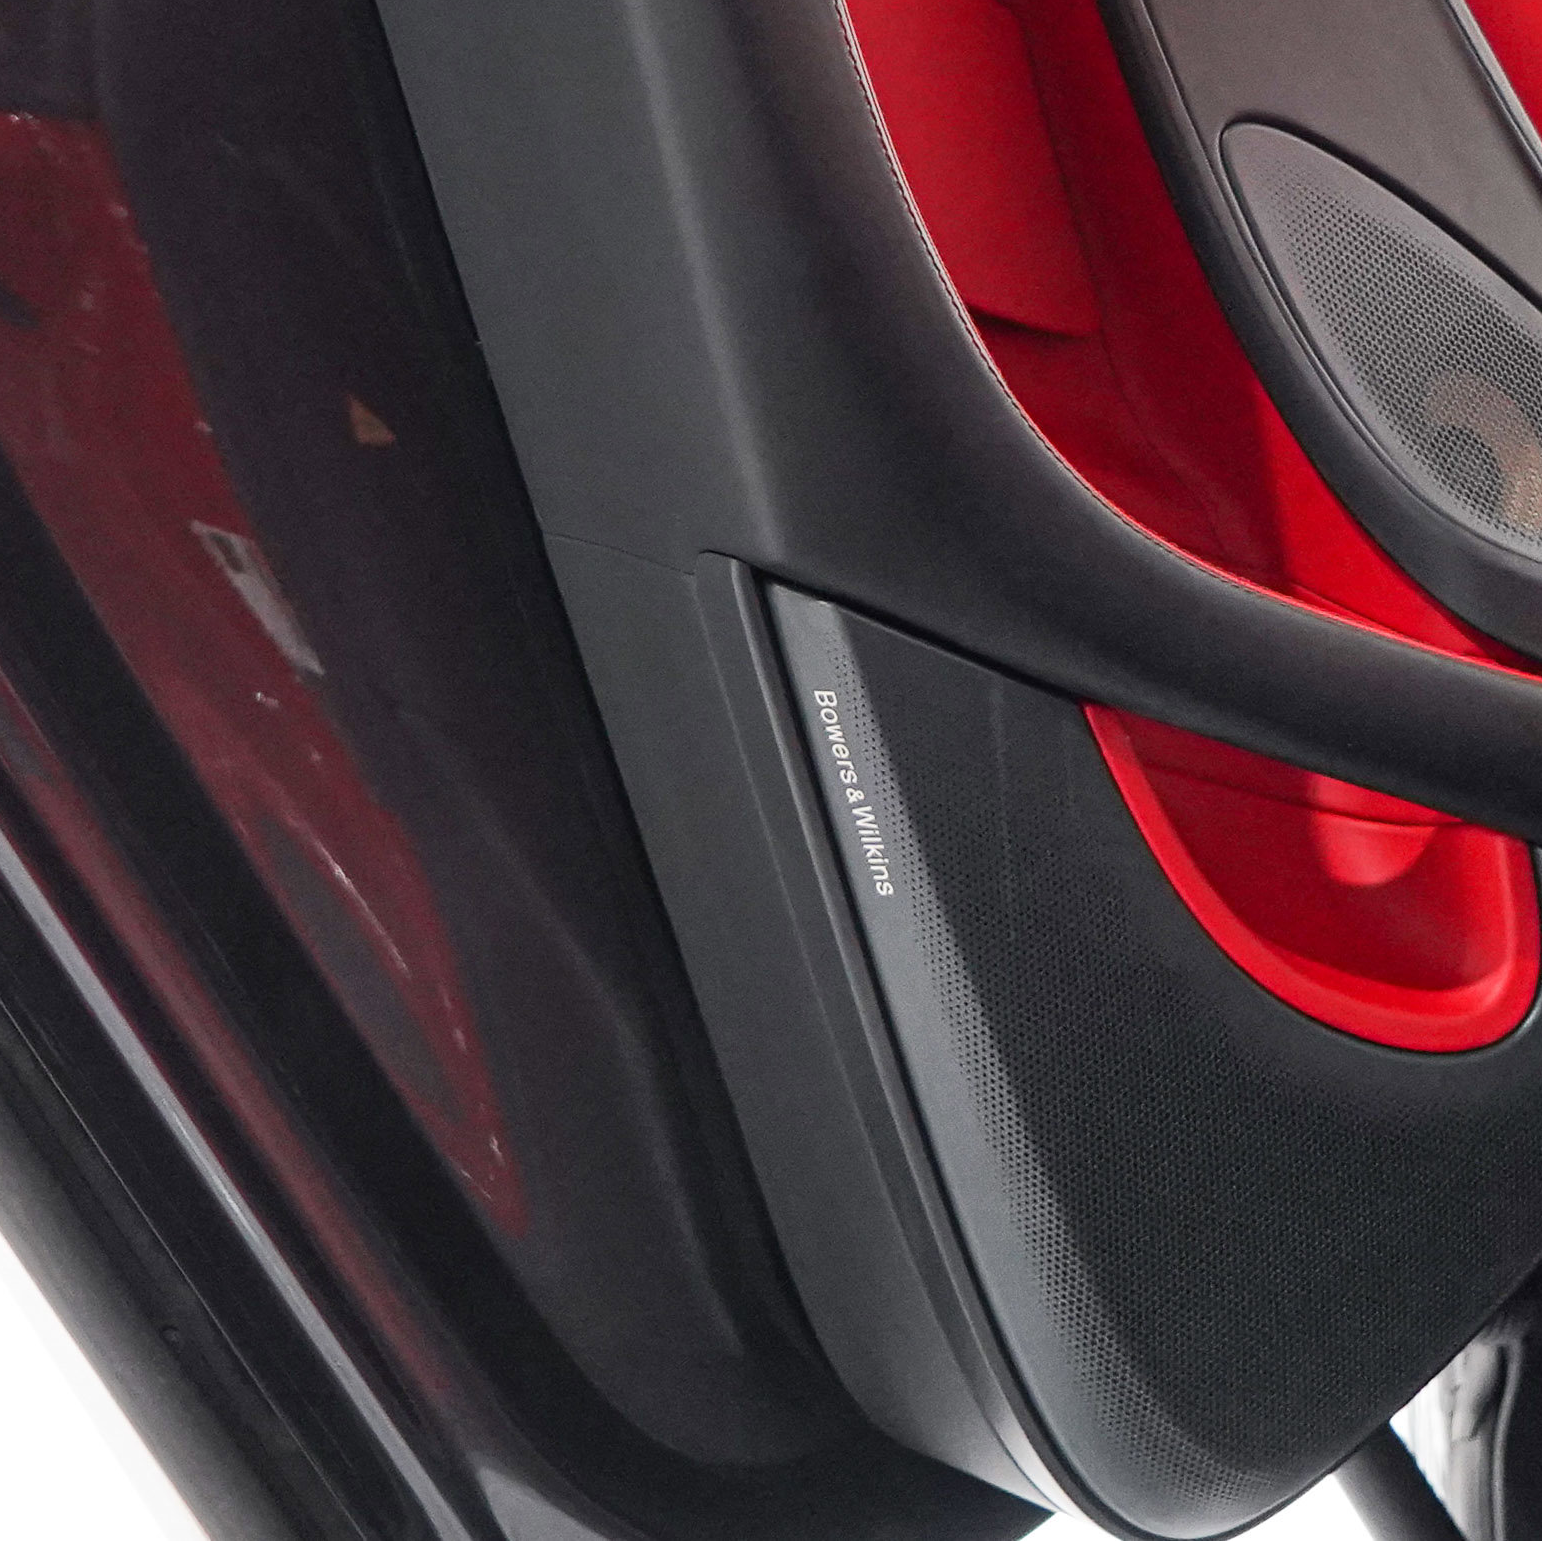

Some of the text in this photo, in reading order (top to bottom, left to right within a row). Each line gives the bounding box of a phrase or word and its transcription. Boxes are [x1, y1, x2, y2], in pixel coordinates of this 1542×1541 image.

[813, 689, 895, 897] Bowers & Wilkins
